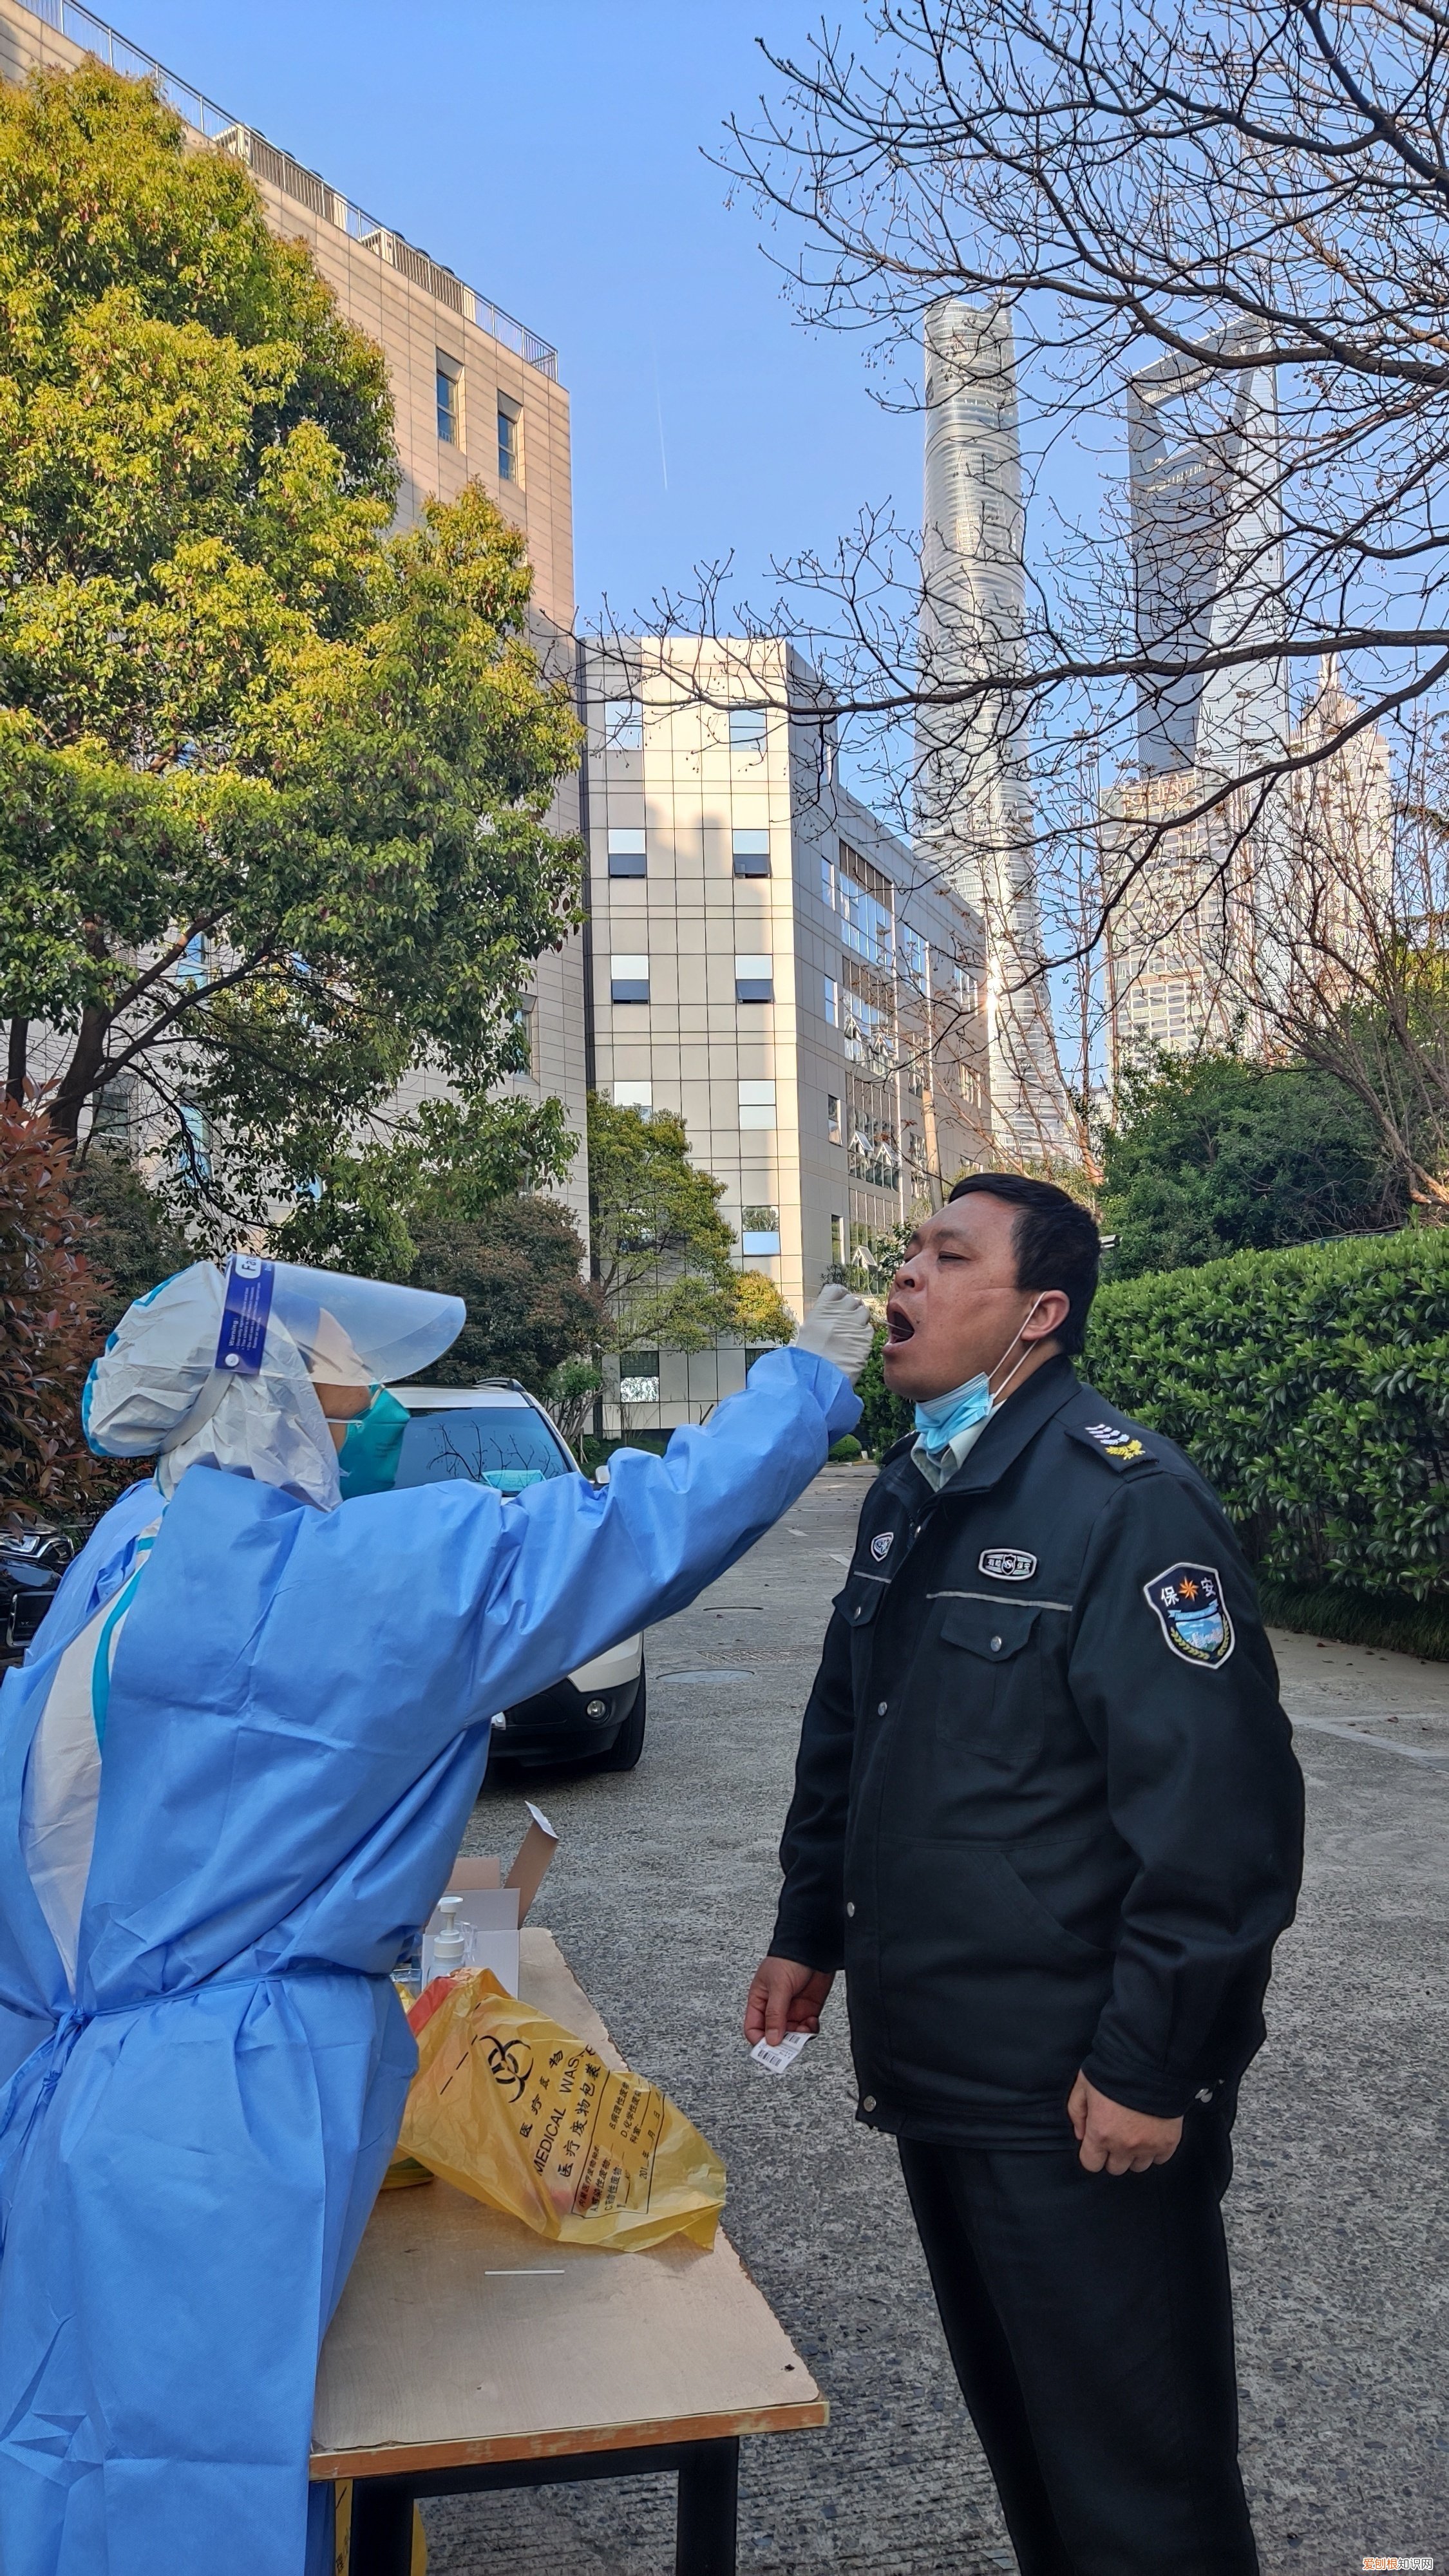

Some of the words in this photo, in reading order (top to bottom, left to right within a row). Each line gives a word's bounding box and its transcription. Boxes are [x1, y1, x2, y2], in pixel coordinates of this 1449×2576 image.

[1161, 1586, 1180, 1607] 保
[1200, 1577, 1216, 1597] 安
[533, 2108, 567, 2176] MEDICAL
